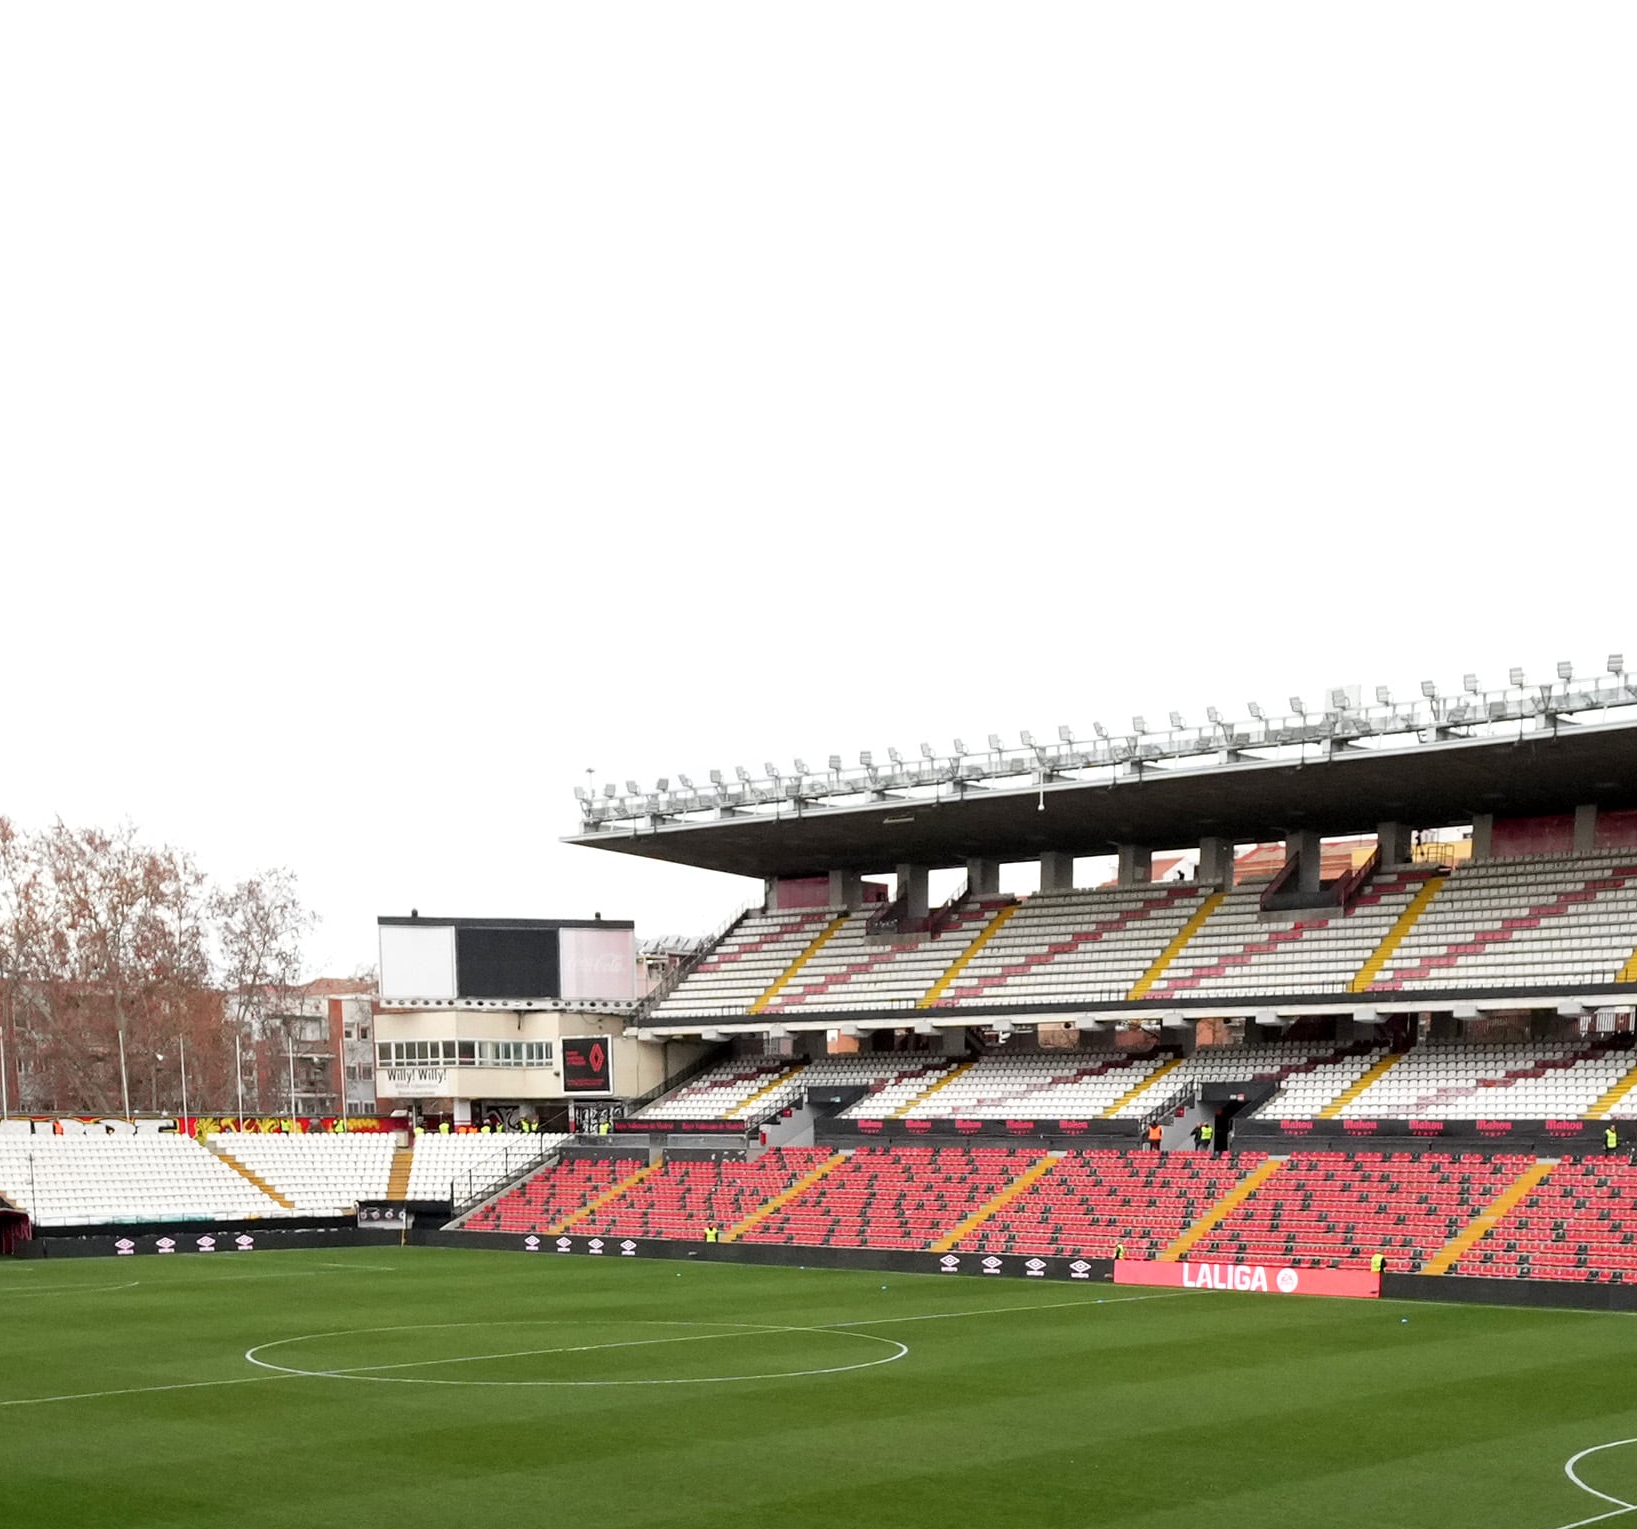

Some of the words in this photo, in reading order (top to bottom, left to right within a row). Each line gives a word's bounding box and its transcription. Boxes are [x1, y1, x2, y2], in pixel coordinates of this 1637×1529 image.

[388, 1069, 415, 1084] Willy!
[418, 1069, 446, 1084] Willy!
[1545, 1120, 1582, 1130] Mahou
[1182, 1262, 1268, 1292] LALIGA
